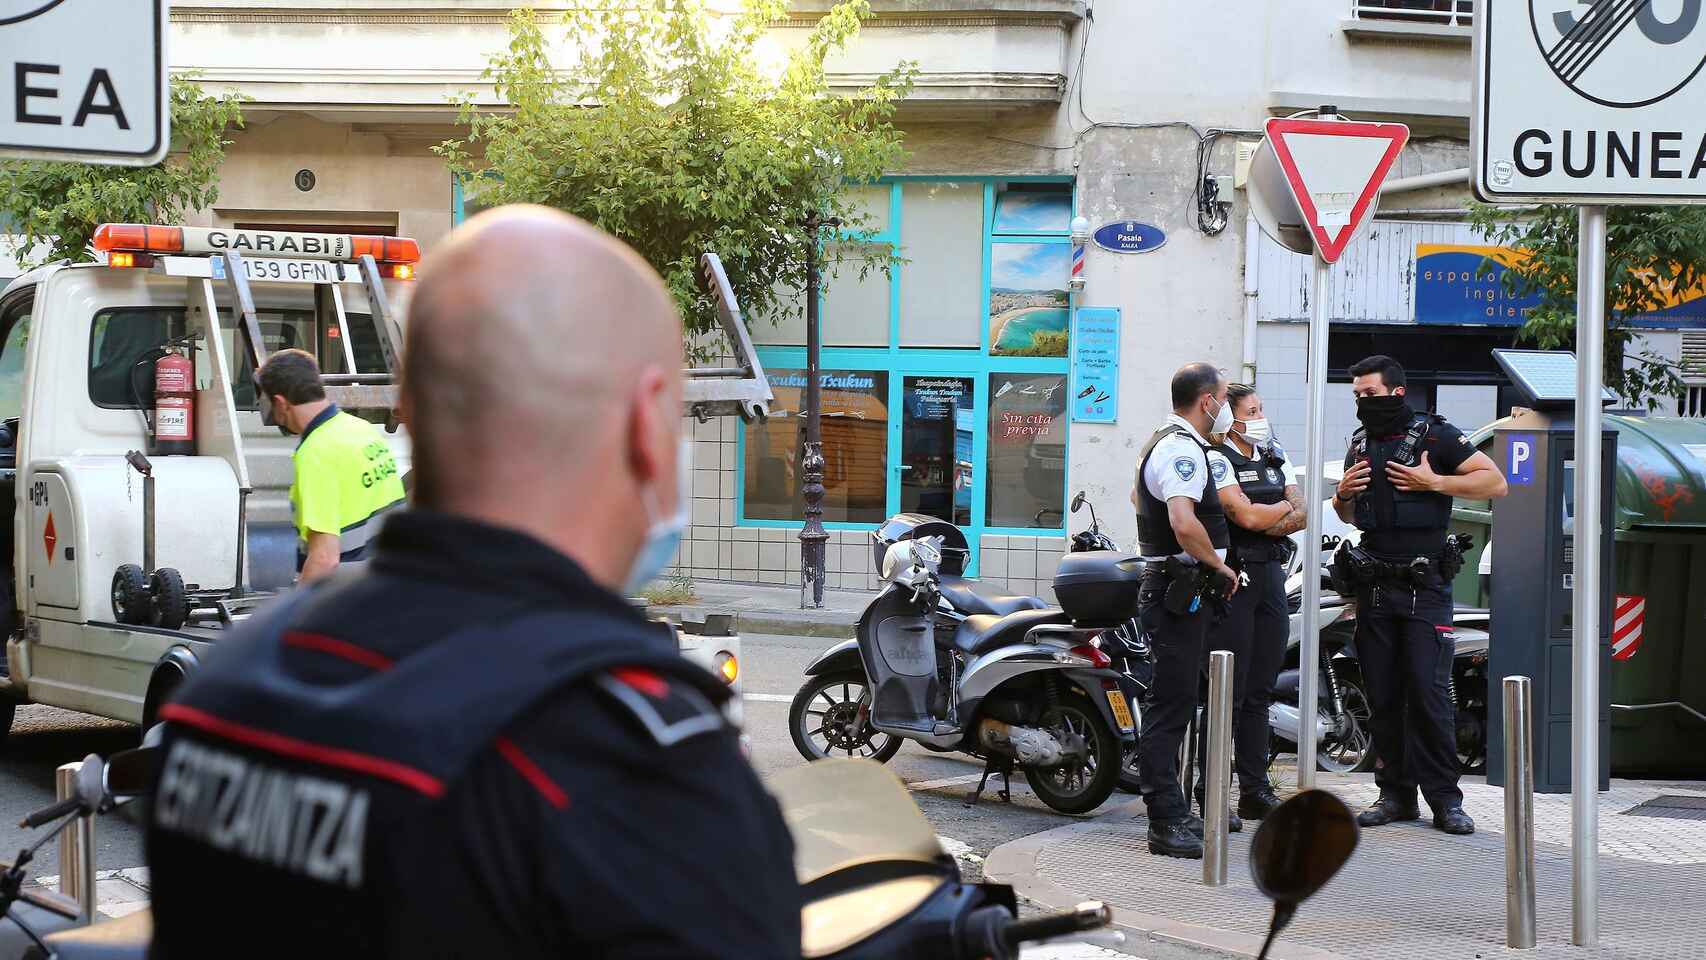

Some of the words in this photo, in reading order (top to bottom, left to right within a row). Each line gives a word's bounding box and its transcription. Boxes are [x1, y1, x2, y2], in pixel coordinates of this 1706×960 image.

[15, 62, 130, 130] EA
[207, 231, 330, 254] GARABI
[1117, 233, 1142, 242] Pasaia
[242, 261, 280, 279] 159
[287, 262, 327, 281] GFN
[819, 374, 875, 389] Txukun
[1001, 412, 1024, 424] Sin
[1026, 414, 1053, 424] cita
[1002, 425, 1049, 438] previa
[1512, 441, 1530, 475] P
